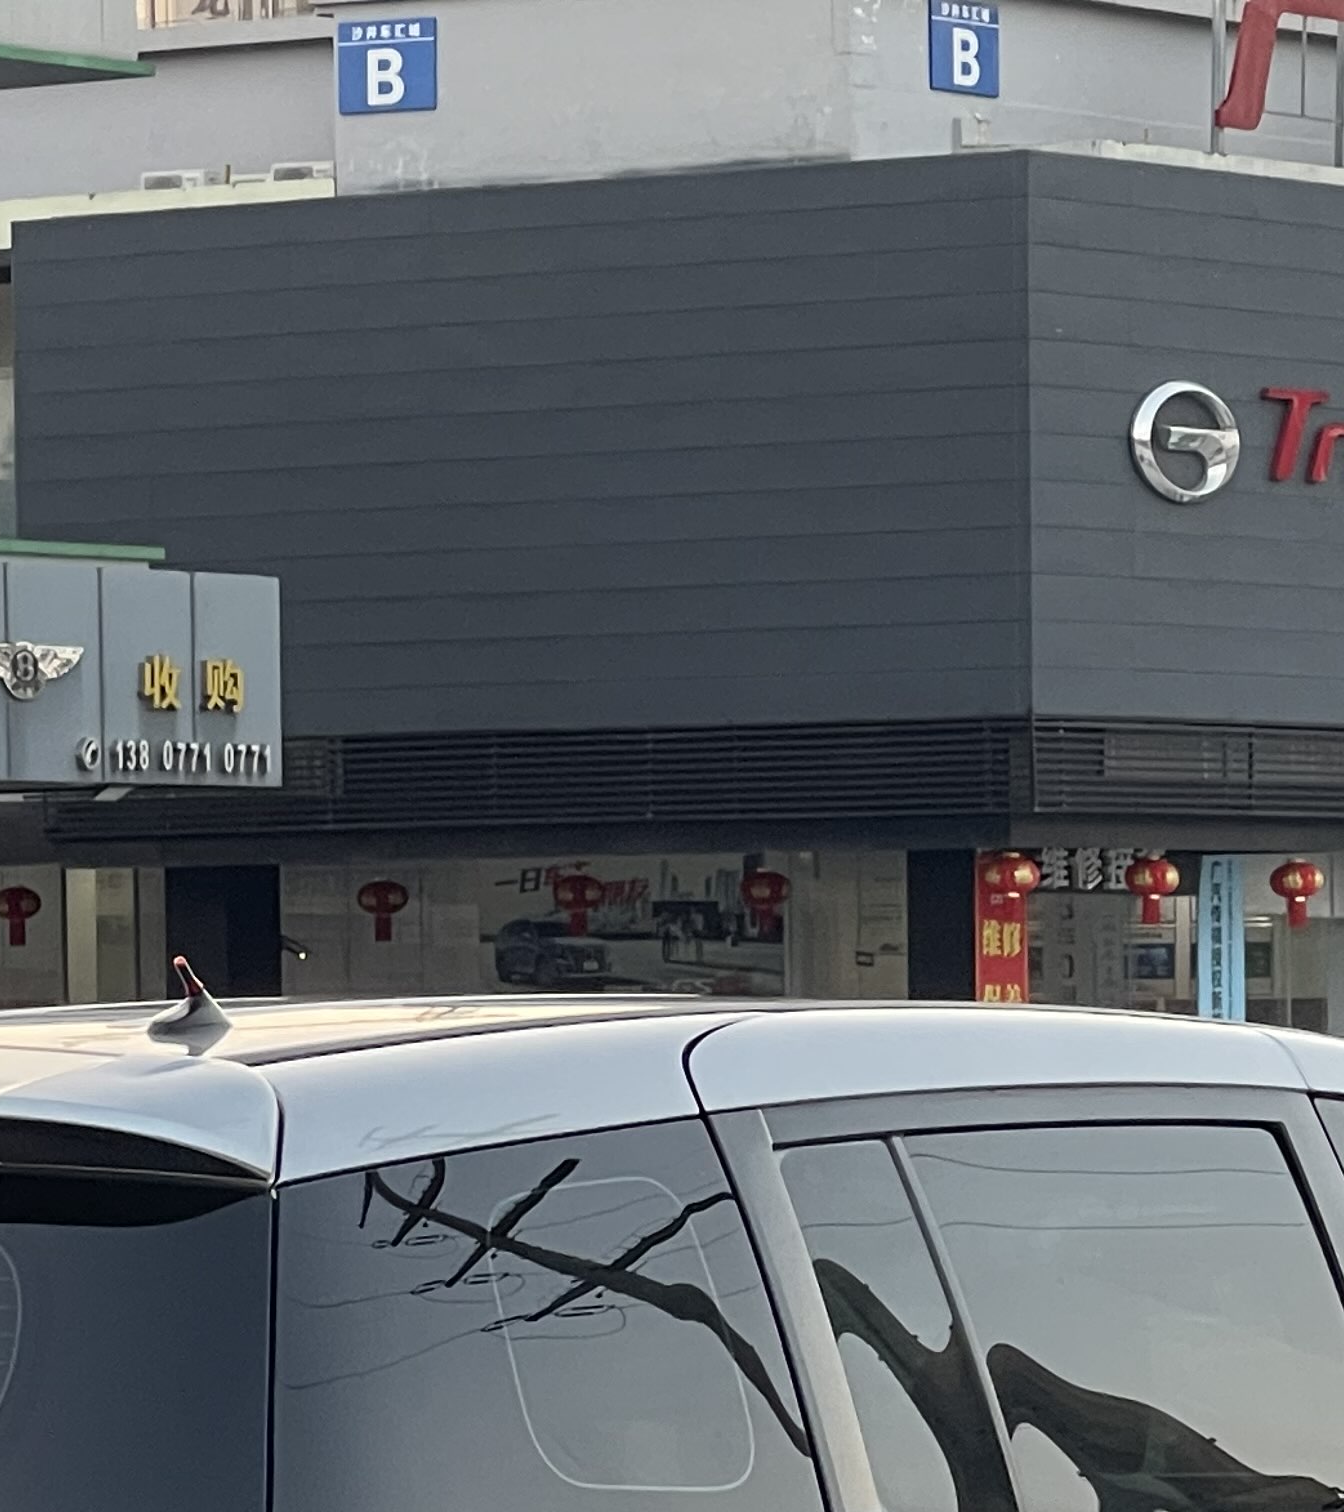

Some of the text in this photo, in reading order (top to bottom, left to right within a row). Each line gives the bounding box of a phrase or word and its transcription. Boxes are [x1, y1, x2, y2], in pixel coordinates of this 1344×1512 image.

[367, 48, 405, 106] B
[952, 27, 981, 87] B
[143, 652, 245, 713] 收购
[115, 738, 272, 773] 138 0771 0771
